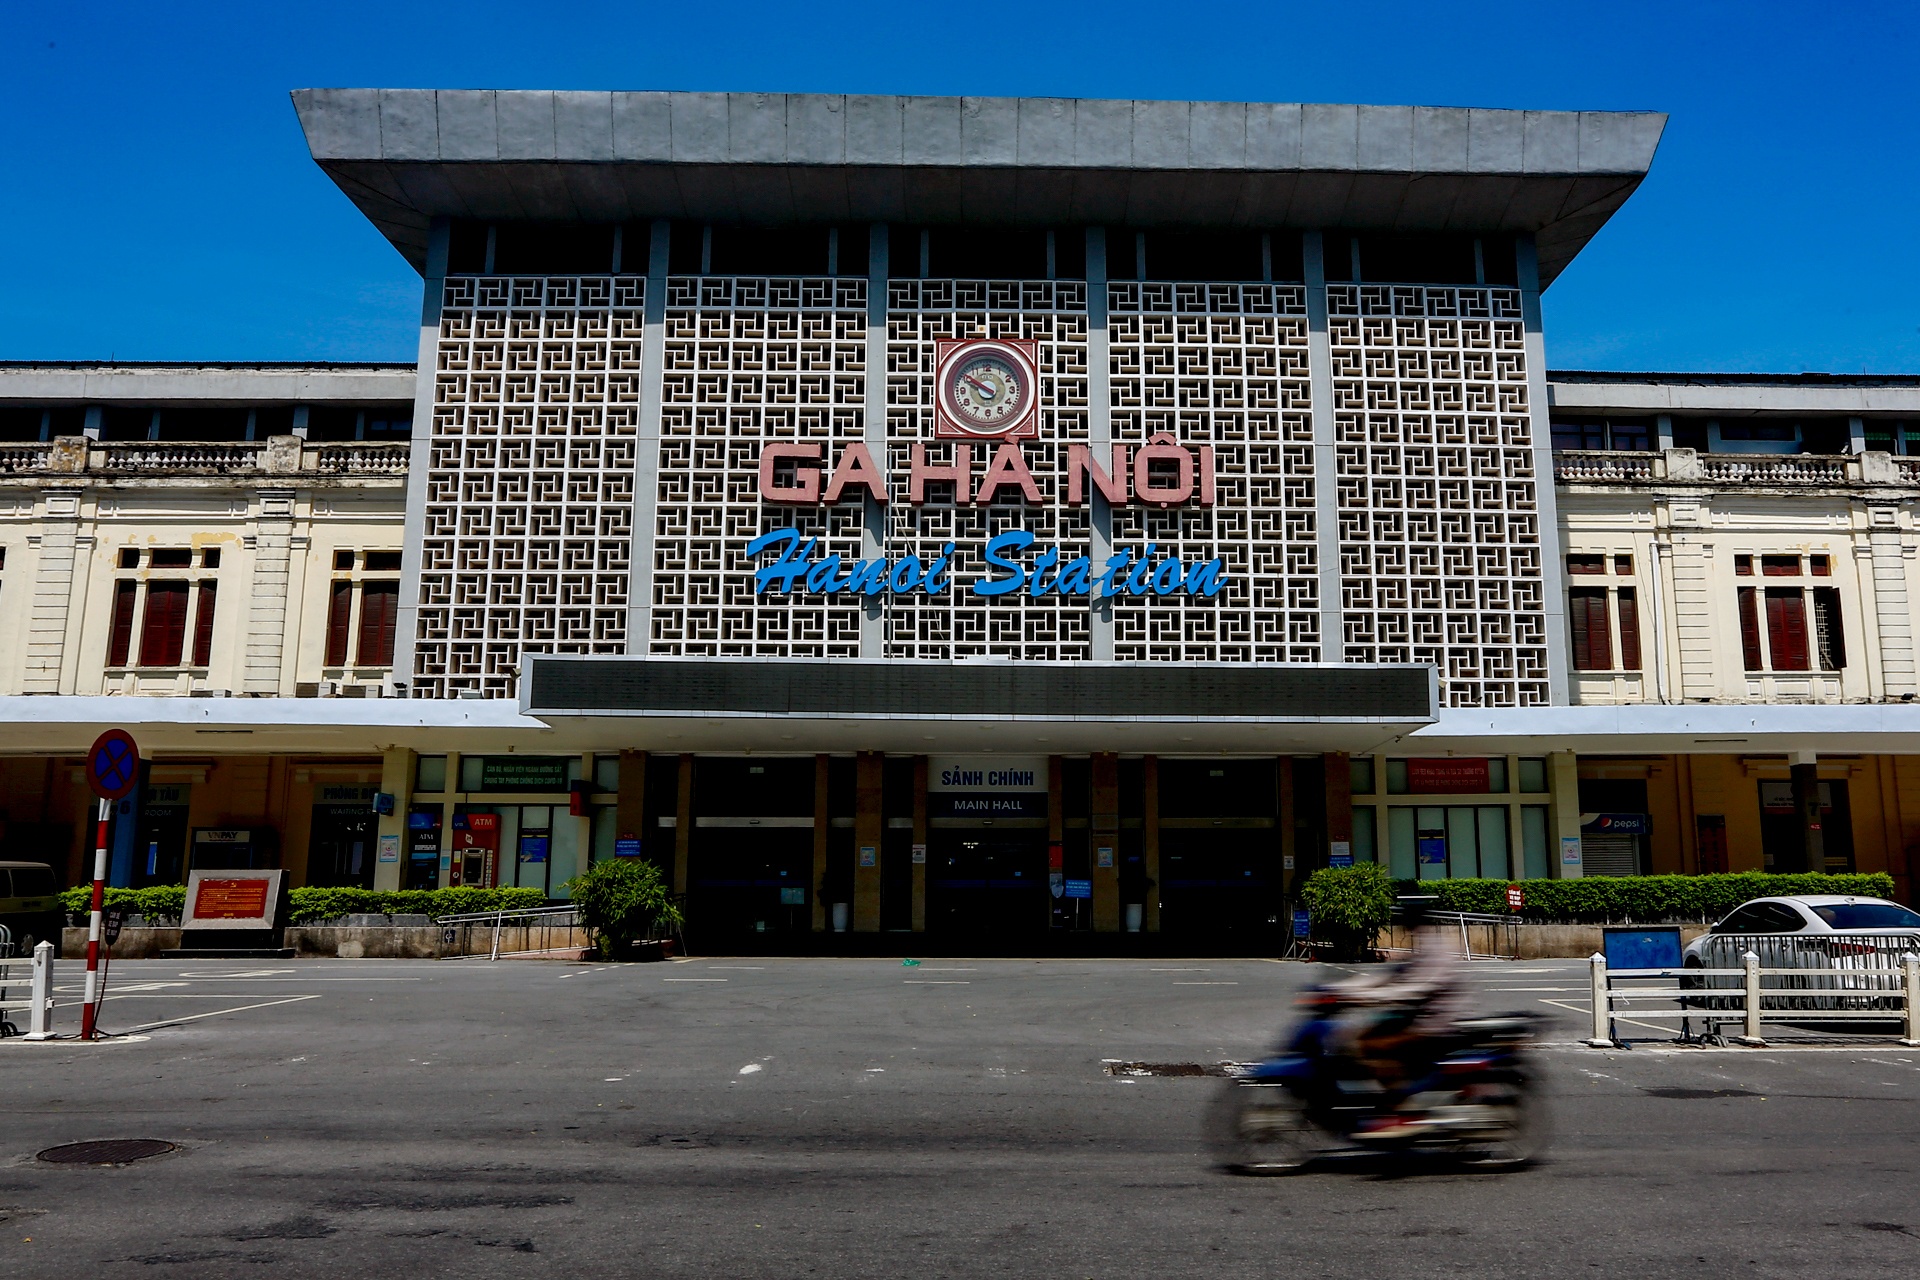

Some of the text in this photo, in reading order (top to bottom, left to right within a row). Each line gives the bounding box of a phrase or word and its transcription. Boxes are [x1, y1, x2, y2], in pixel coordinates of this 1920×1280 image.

[982, 364, 991, 372] 12
[1005, 375, 1012, 383] 2
[1009, 386, 1015, 394] 3
[963, 398, 970, 406] 8
[973, 407, 979, 415] 7
[985, 409, 991, 417] 6
[997, 406, 1004, 415] 5
[758, 432, 1214, 509] GA HÀ NỘI
[746, 527, 1229, 598] Hanoi Station
[941, 765, 1034, 786] SẢNH CHÍNH
[323, 785, 358, 800] PHÒNG
[120, 800, 131, 814] 6
[954, 800, 1023, 810] MAIN HALL
[474, 818, 492, 826] ATM
[1613, 819, 1639, 829] pepsi
[207, 831, 239, 839] VNPAY
